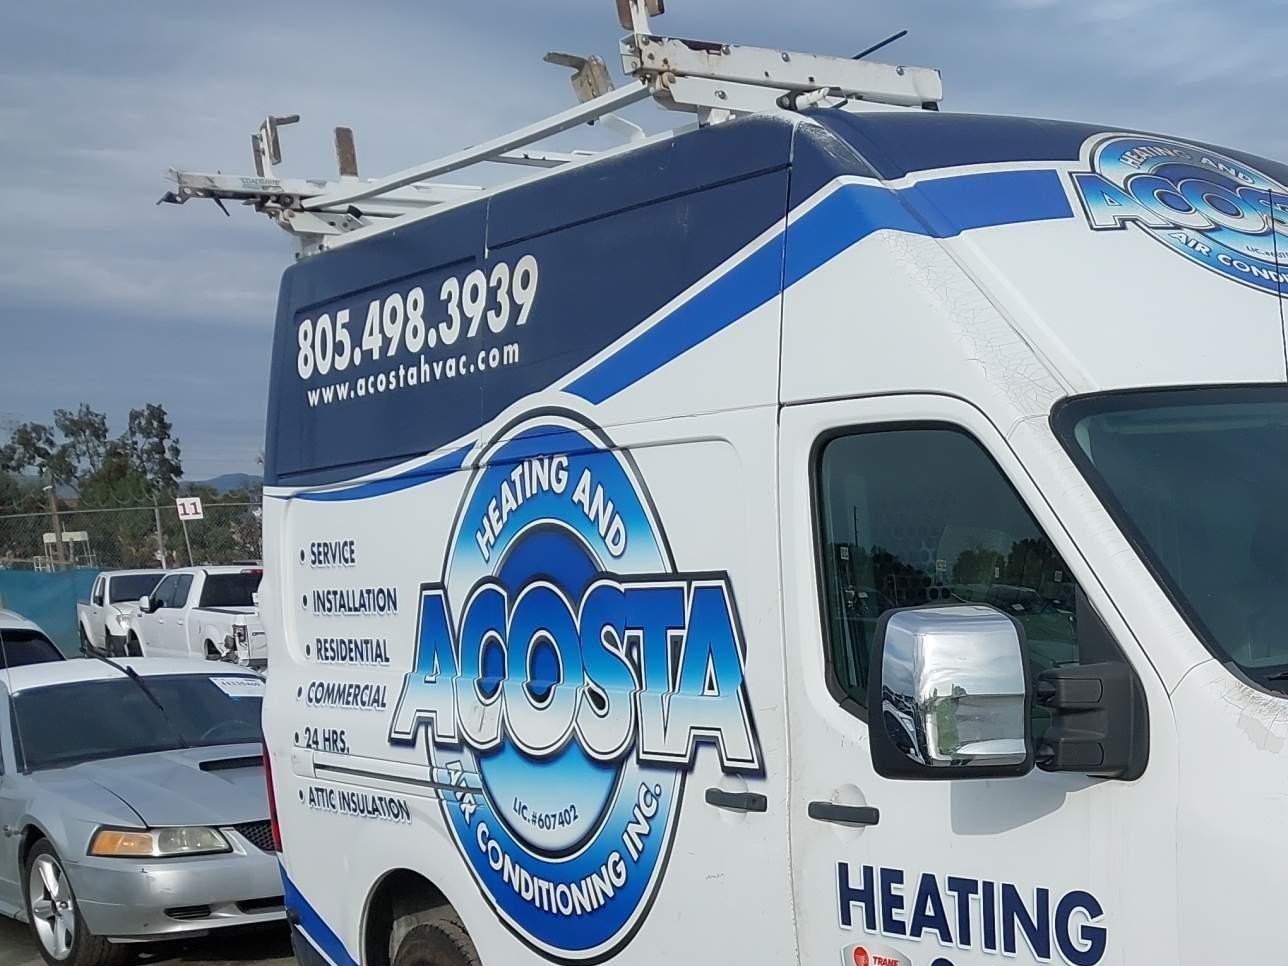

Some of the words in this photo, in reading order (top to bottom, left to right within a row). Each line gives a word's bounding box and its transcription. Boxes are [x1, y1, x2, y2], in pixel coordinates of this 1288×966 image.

[1201, 157, 1255, 184] AND
[1169, 230, 1212, 257] AIR
[297, 254, 539, 380] 805.498.3939
[307, 341, 520, 407] www.acostahvac.com
[179, 502, 201, 516] 11
[475, 454, 570, 562] HEATING
[573, 469, 627, 558] AND
[310, 540, 355, 565] SERVICE
[312, 587, 397, 612] INSTALLATION
[316, 638, 390, 663] RESIDENTIAL
[389, 571, 766, 776] ACOSTA
[307, 681, 387, 708] COMMERCIAL
[304, 726, 319, 749] 24
[323, 729, 350, 754] HRS.
[309, 786, 336, 810] ATTIC
[338, 791, 411, 821] INSULATION
[476, 826, 627, 917] CONDITIONING
[622, 782, 663, 862] INC.
